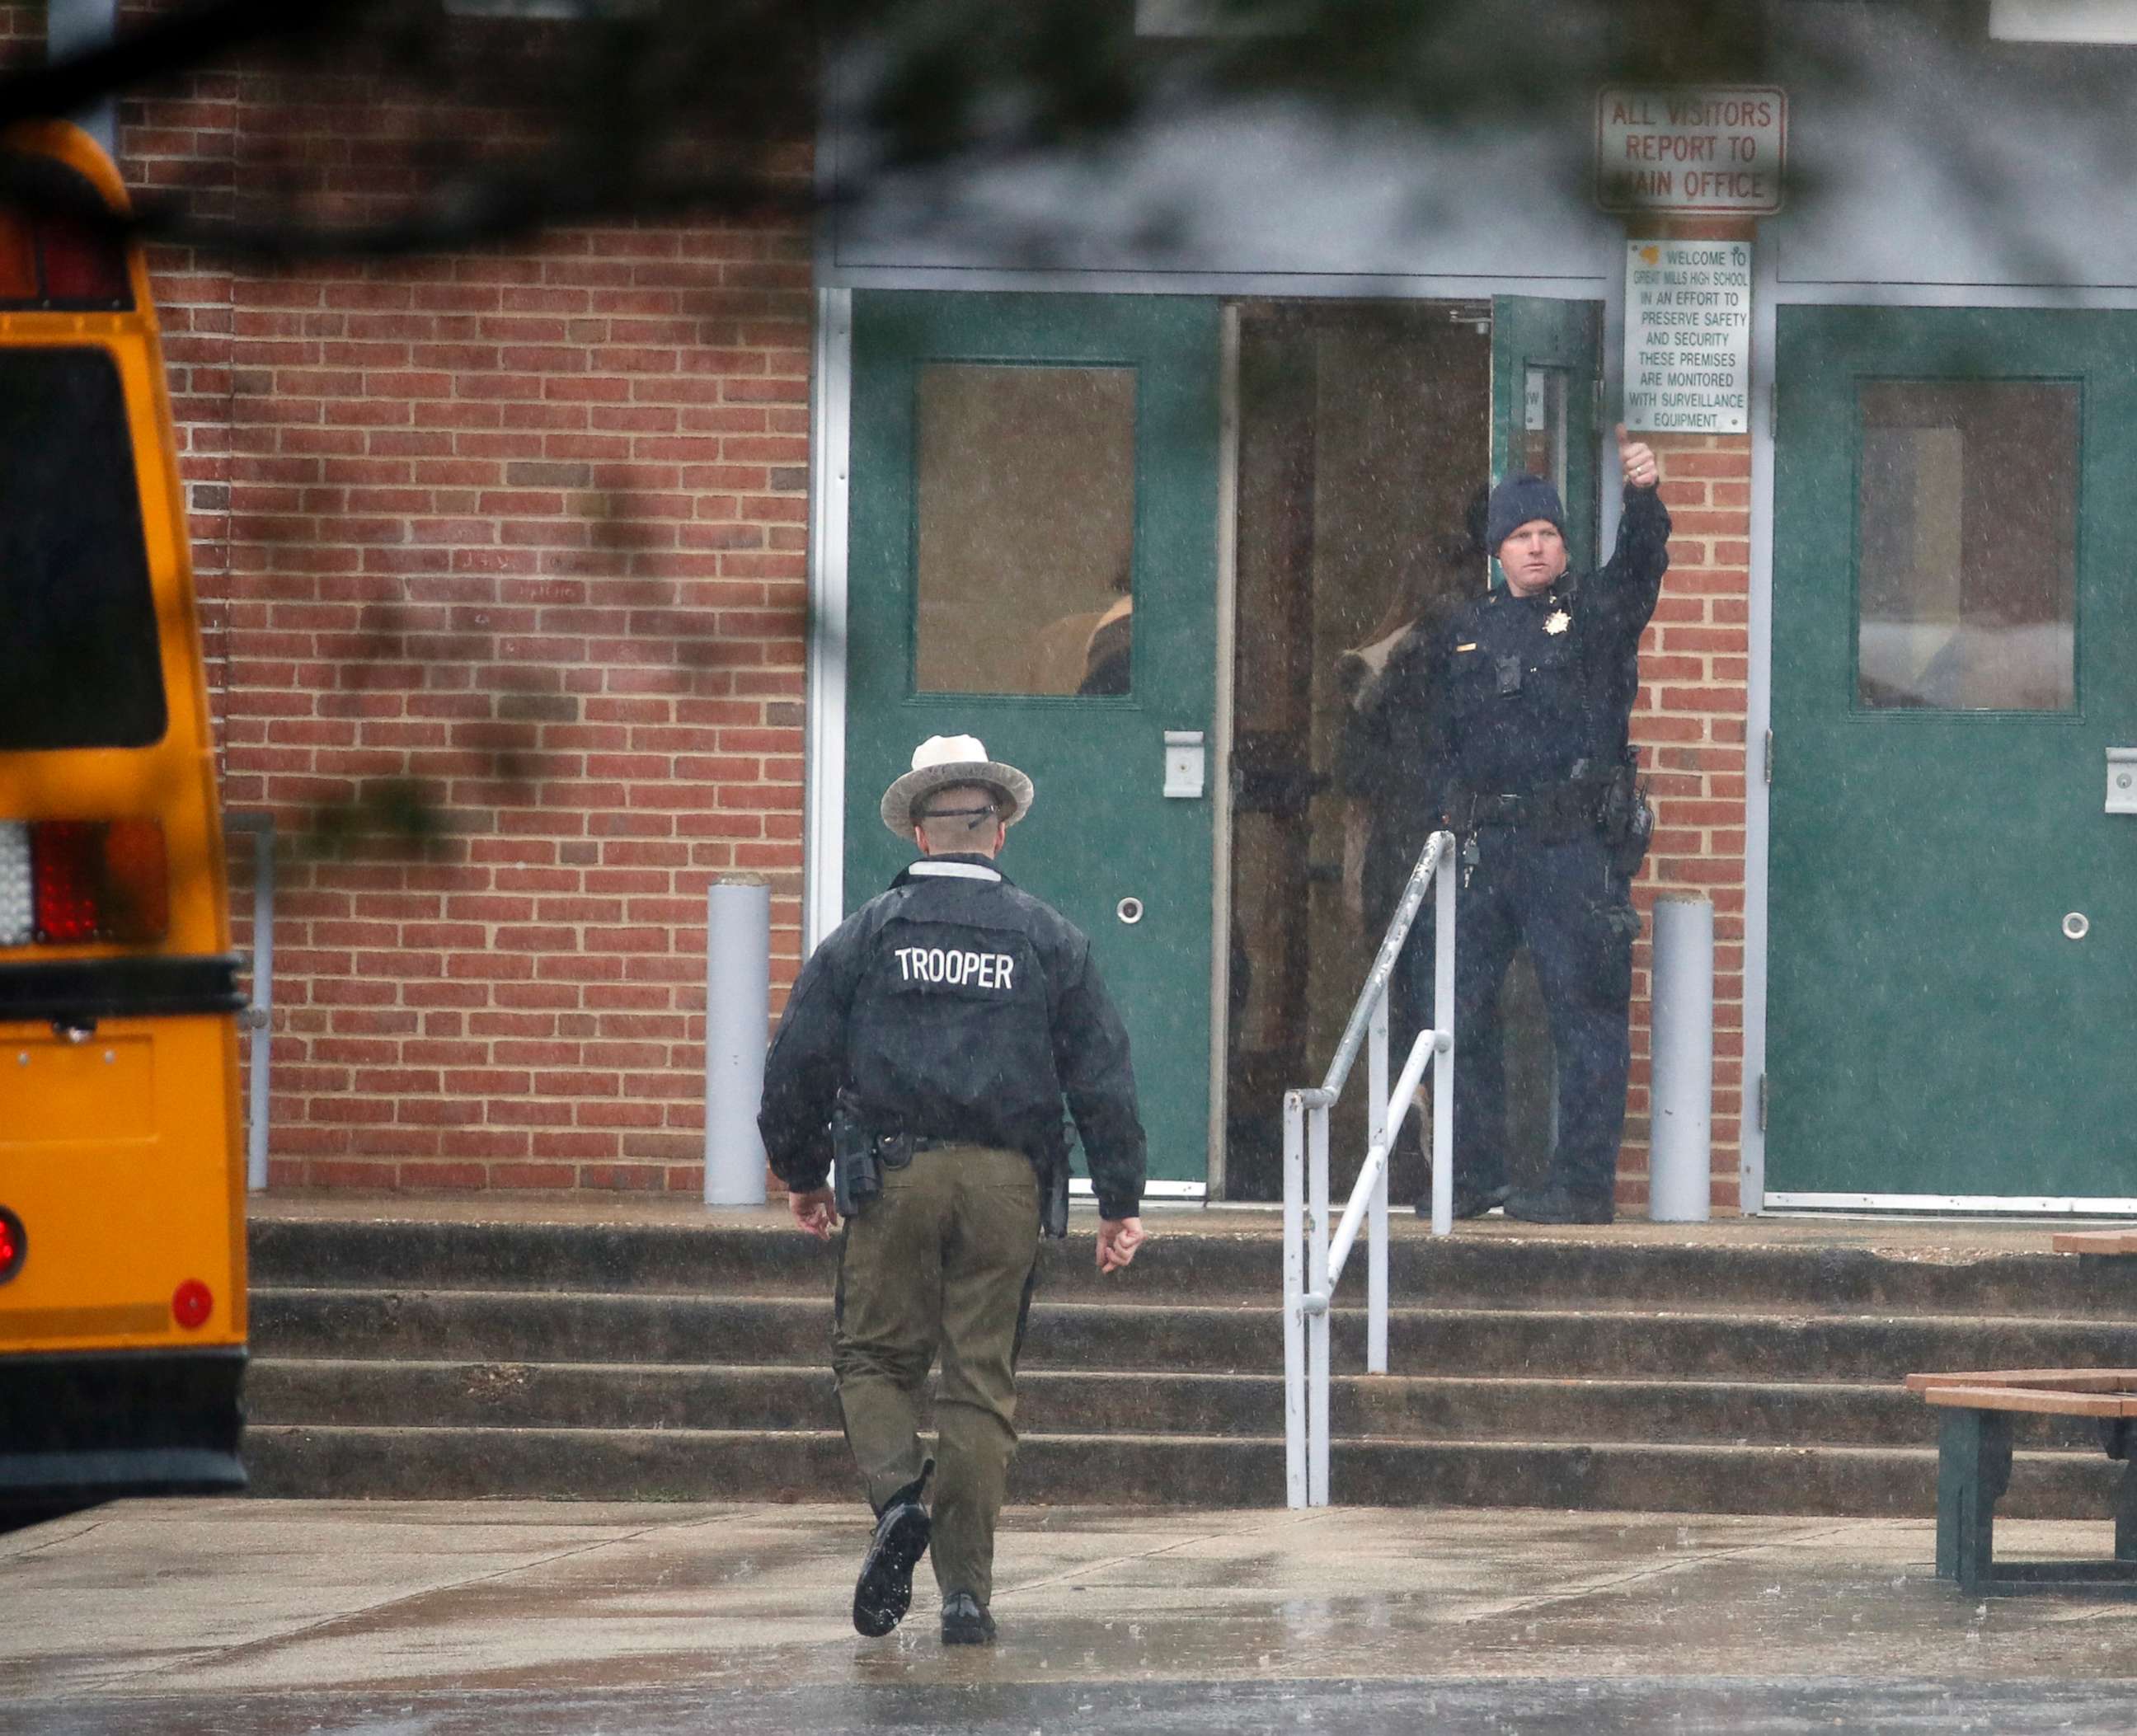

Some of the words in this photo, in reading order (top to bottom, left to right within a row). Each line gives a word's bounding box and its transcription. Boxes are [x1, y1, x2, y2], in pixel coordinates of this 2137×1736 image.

[1613, 102, 1656, 125] ALL
[1668, 101, 1771, 128] VISITORS
[1626, 134, 1717, 162] REPORT
[1728, 136, 1755, 162] TO
[1684, 171, 1764, 199] OFFICE
[1667, 251, 1726, 265] WELCOME
[1731, 251, 1746, 266] TO
[1664, 271, 1687, 284] MILLS
[1690, 272, 1710, 285] HIGH
[1714, 272, 1748, 286] SCHOOL
[1641, 293, 1652, 304] IN
[1656, 293, 1672, 305] AN
[1677, 292, 1720, 306] EFFORT
[1725, 293, 1738, 306] TO
[1641, 312, 1699, 325] PRESERVE
[1704, 313, 1747, 326] SAFETY
[1646, 332, 1670, 345] AND
[1674, 333, 1729, 346] SECURITY
[1639, 352, 1674, 365] THESE
[1679, 353, 1735, 367] PREMISES
[1641, 373, 1662, 386] ARE
[1668, 373, 1733, 387] MONITORED
[1629, 392, 1656, 406] WITH
[1662, 393, 1744, 408] SURVEILLANCE
[1654, 413, 1717, 427] EQUIPMENT
[895, 946, 1014, 989] TROOPER
